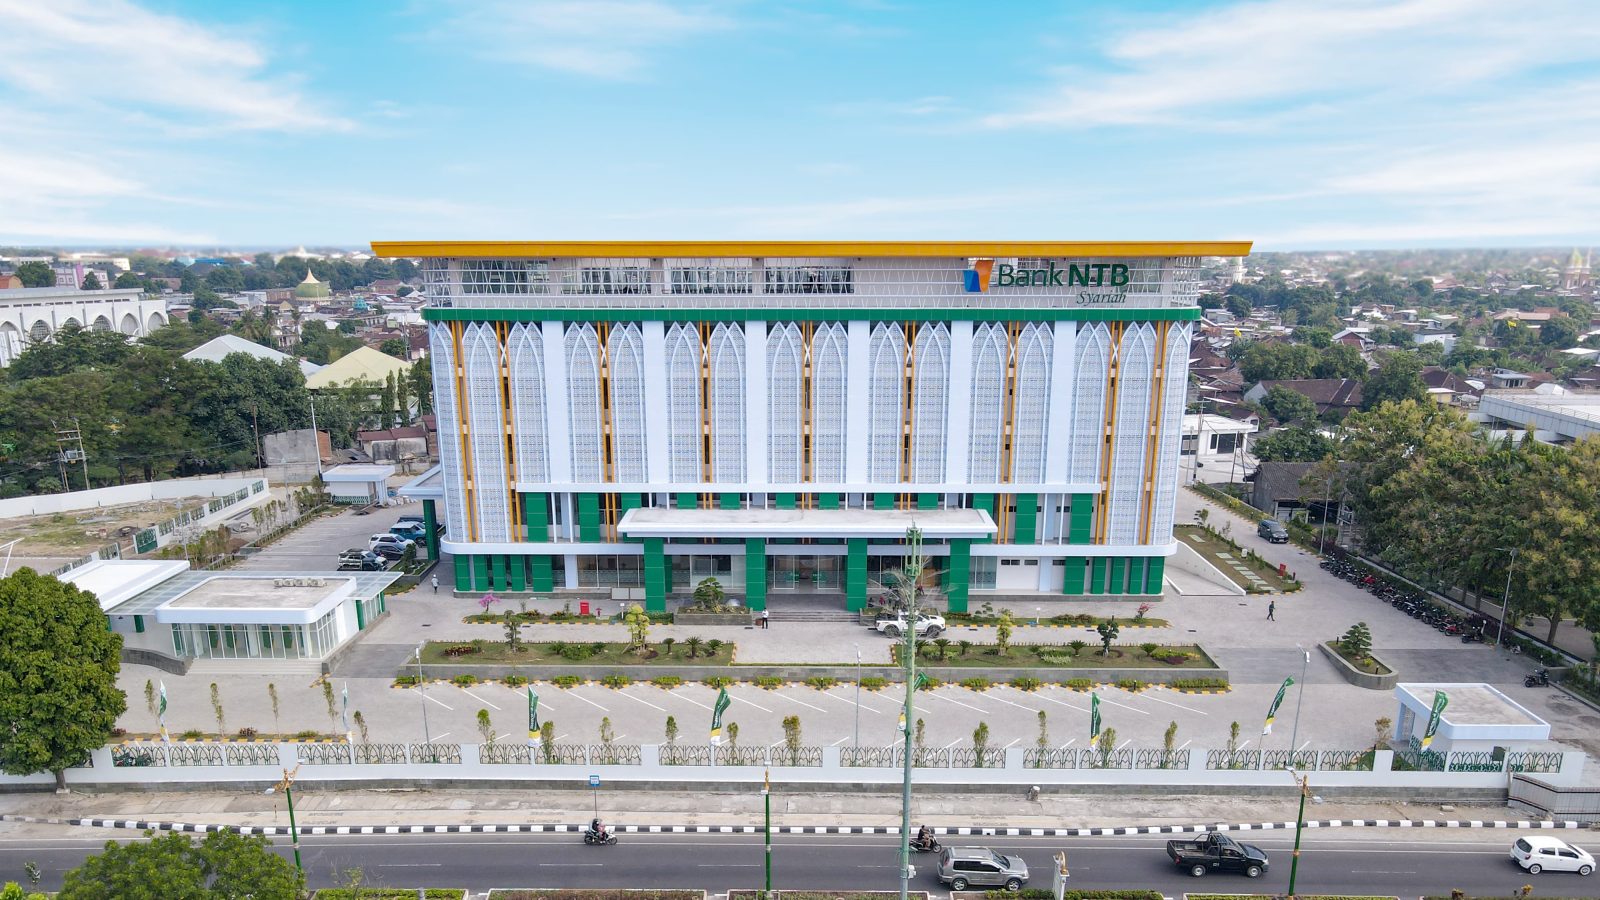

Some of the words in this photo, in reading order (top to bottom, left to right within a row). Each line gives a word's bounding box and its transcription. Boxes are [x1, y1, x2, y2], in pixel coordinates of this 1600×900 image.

[999, 262, 1063, 287] Bank
[1069, 263, 1129, 287] NTB
[1077, 290, 1127, 306] Syariah
